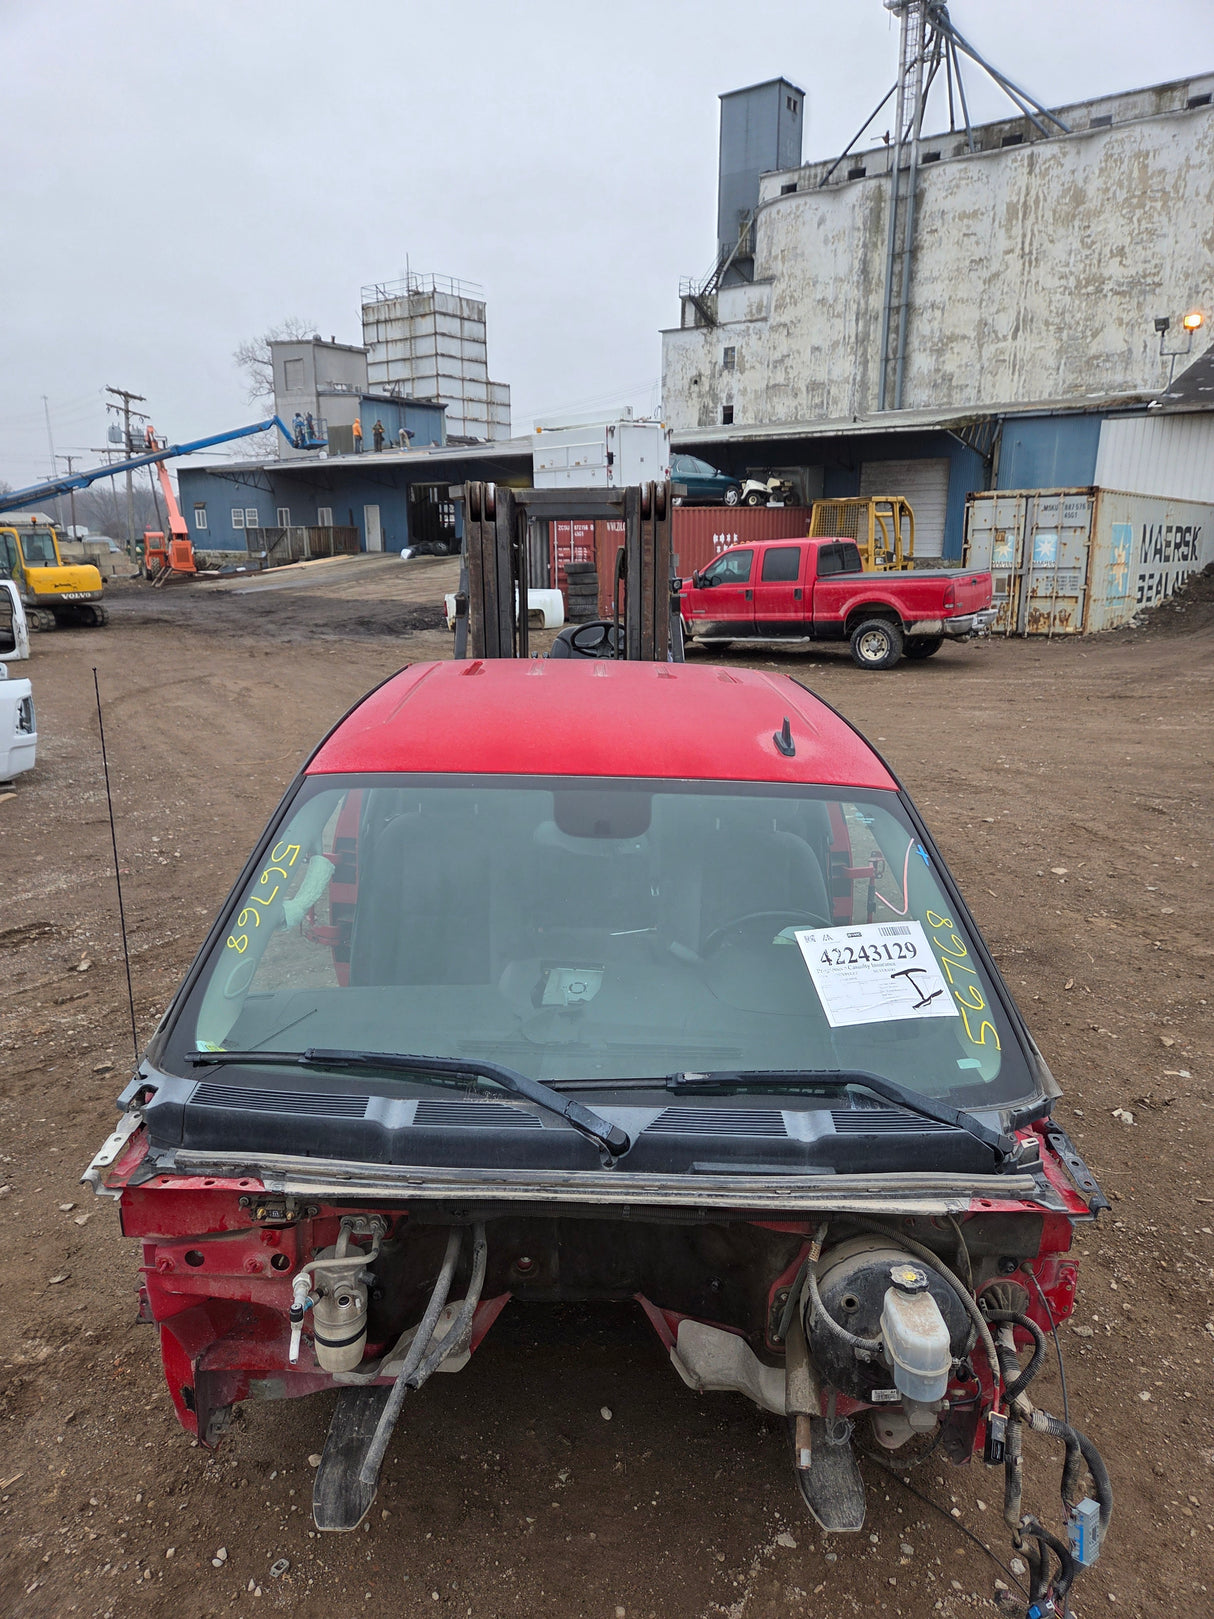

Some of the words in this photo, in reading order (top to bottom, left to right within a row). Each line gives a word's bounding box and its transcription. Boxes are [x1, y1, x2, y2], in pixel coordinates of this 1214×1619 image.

[1140, 524, 1201, 563] MAERSK
[61, 592, 91, 600] VOLVO
[1137, 570, 1196, 604] SEALAN
[227, 841, 300, 953] 56768
[820, 941, 918, 966] 42243129
[926, 910, 1001, 1050] 56768
